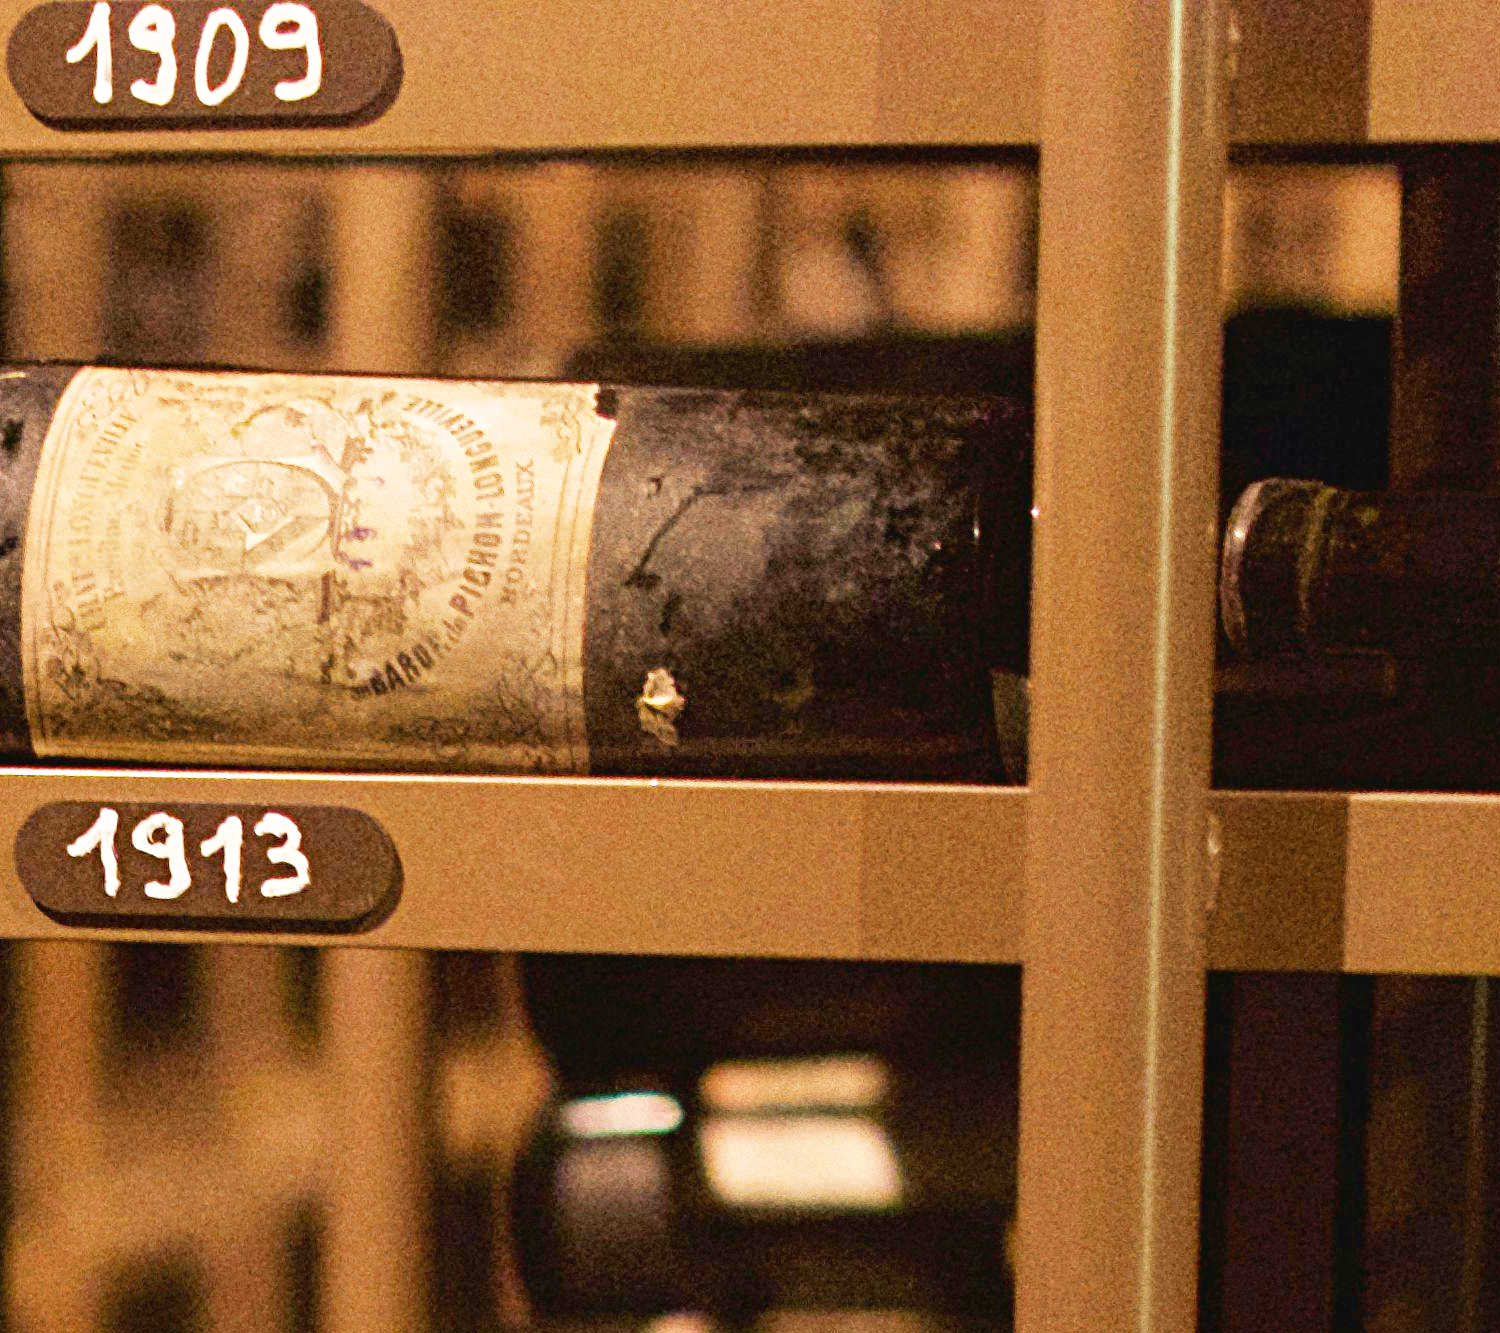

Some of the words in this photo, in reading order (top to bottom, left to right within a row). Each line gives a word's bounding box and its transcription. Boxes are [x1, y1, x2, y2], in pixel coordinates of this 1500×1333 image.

[64, 0, 324, 108] 1909
[401, 392, 506, 618] PICHON-LONGUEVILLE
[501, 457, 536, 603] BORDEAUX
[65, 806, 313, 905] 1913
